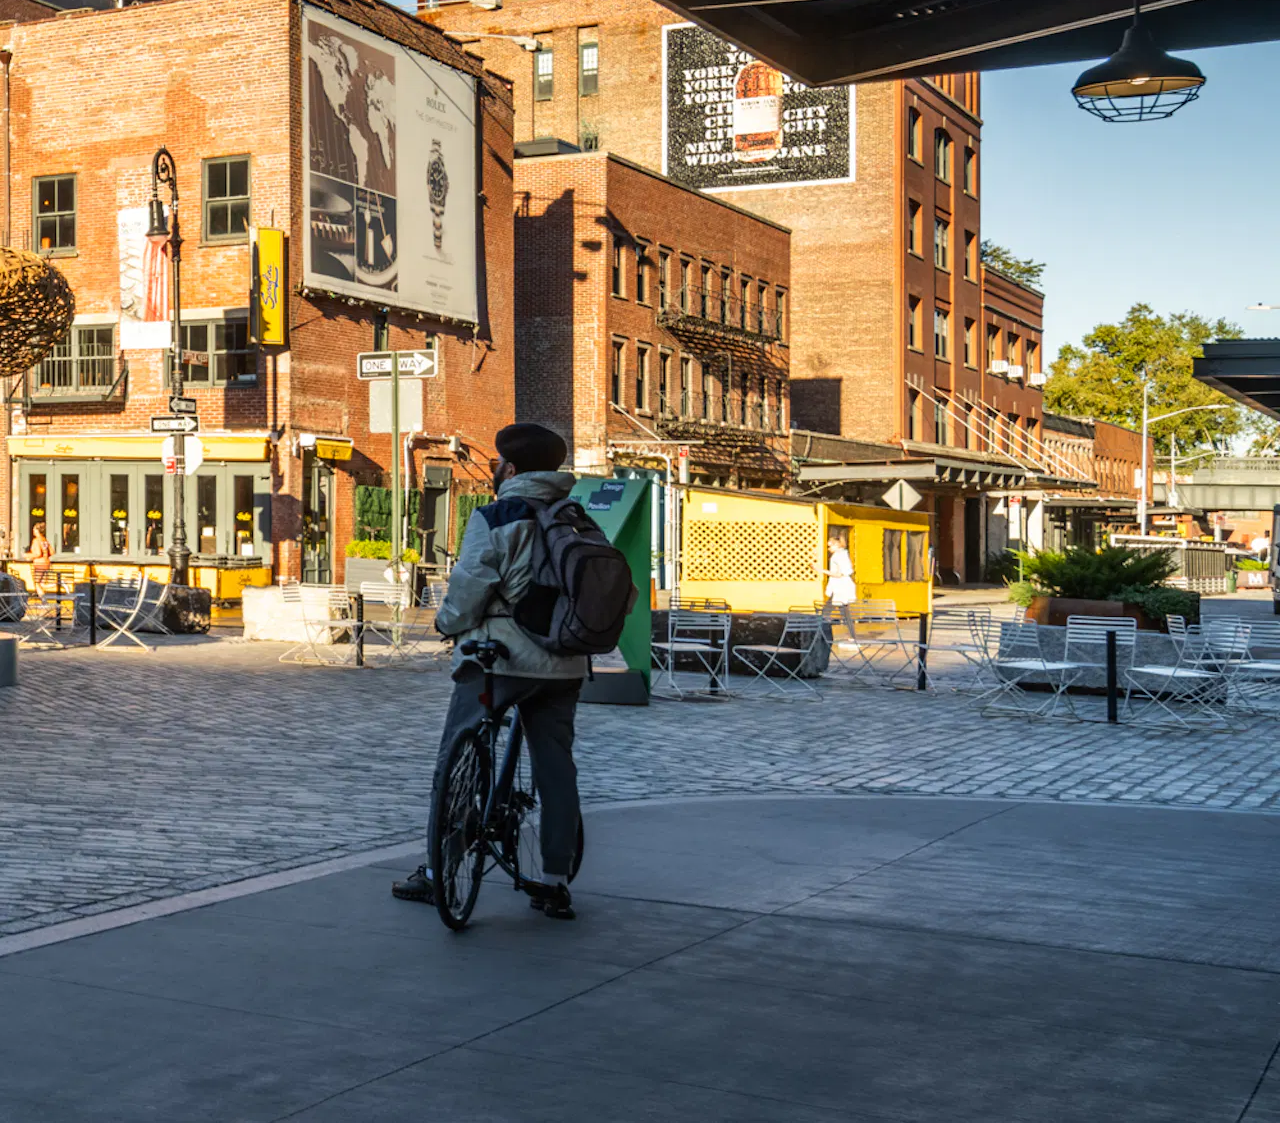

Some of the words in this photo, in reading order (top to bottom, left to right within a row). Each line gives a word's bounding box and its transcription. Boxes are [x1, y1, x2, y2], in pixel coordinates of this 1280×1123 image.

[682, 65, 735, 81] YORK
[682, 77, 734, 93] YORK
[425, 96, 447, 114] ROLEX
[682, 90, 734, 105] YORK
[782, 105, 830, 121] CITY
[783, 118, 829, 133] CITY
[685, 139, 725, 154] NEW
[776, 145, 828, 159] JANE
[364, 361, 387, 370] ONE
[399, 359, 424, 370] WAY
[602, 483, 625, 492] Design
[586, 502, 611, 510] Pavilion
